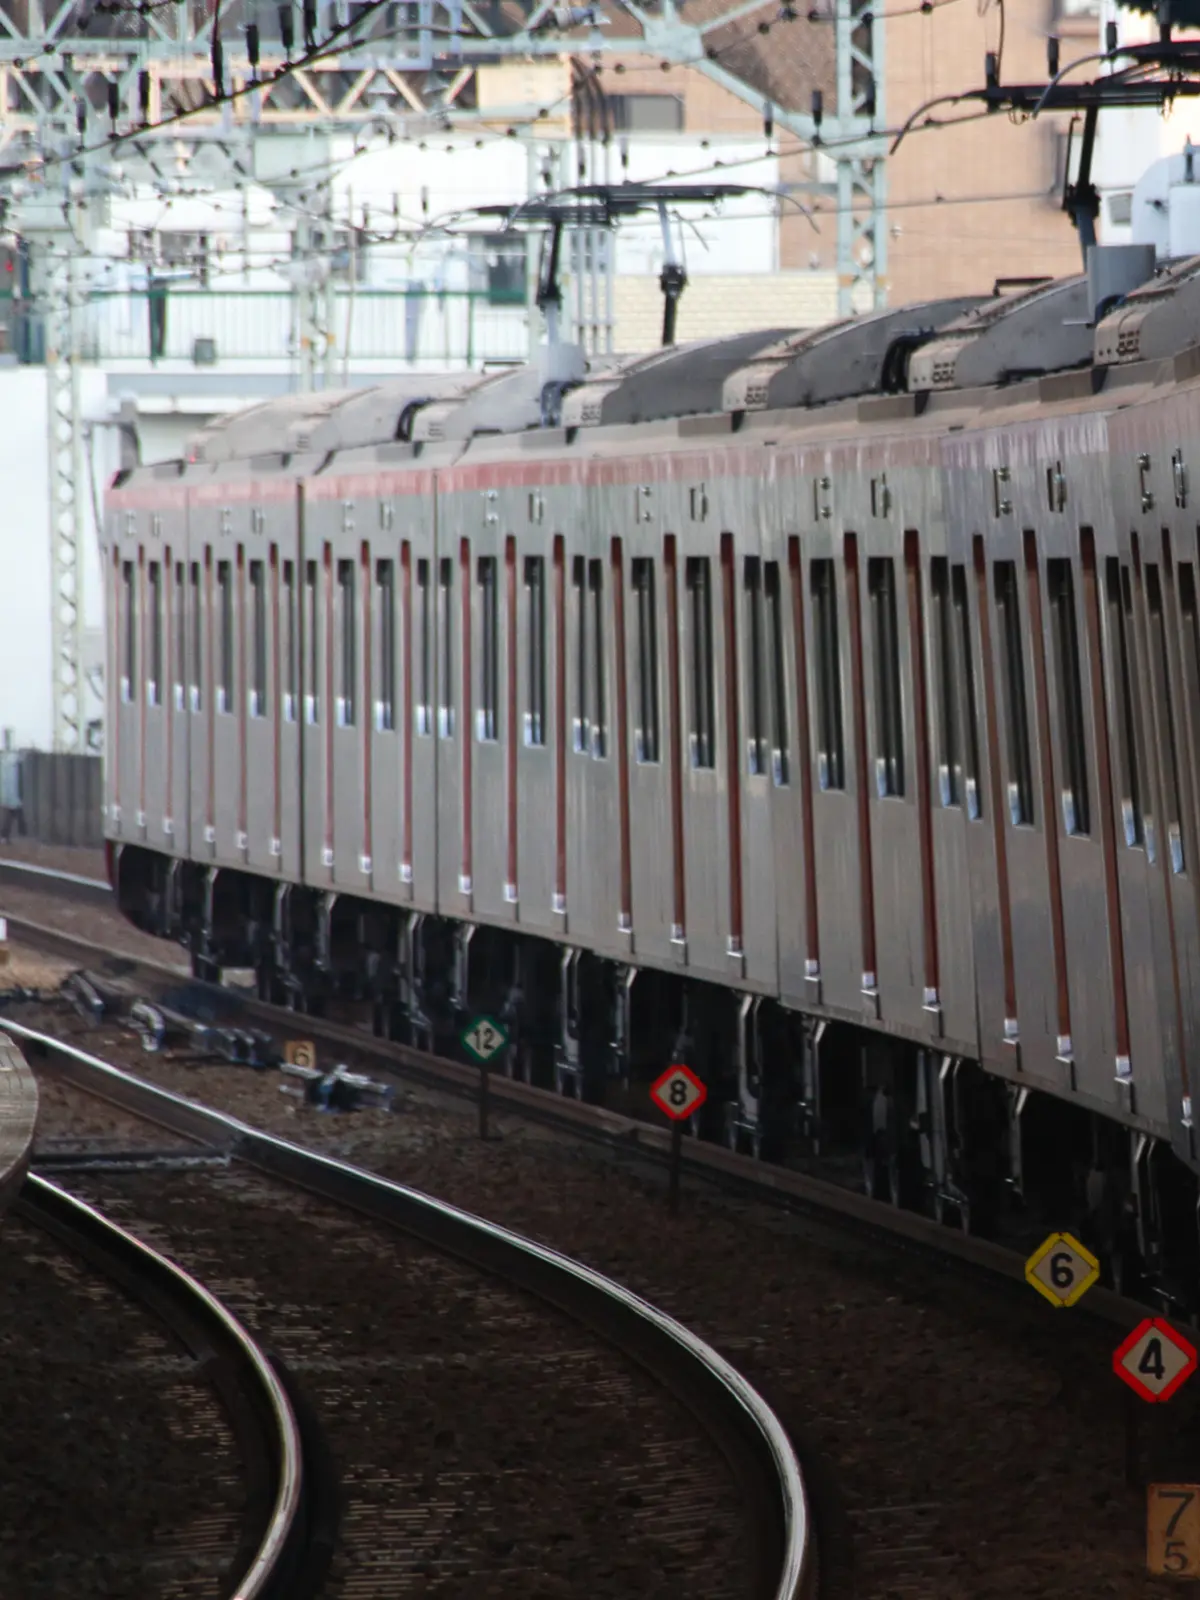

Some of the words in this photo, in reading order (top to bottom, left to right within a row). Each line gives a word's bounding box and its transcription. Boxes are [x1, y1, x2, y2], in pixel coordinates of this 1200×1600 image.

[474, 1027, 496, 1051] 12
[669, 1079, 688, 1106] 8
[1050, 1252, 1075, 1288] 6
[1138, 1338, 1165, 1380] 4
[1158, 1490, 1195, 1537] 7
[1163, 1541, 1188, 1573] 5
